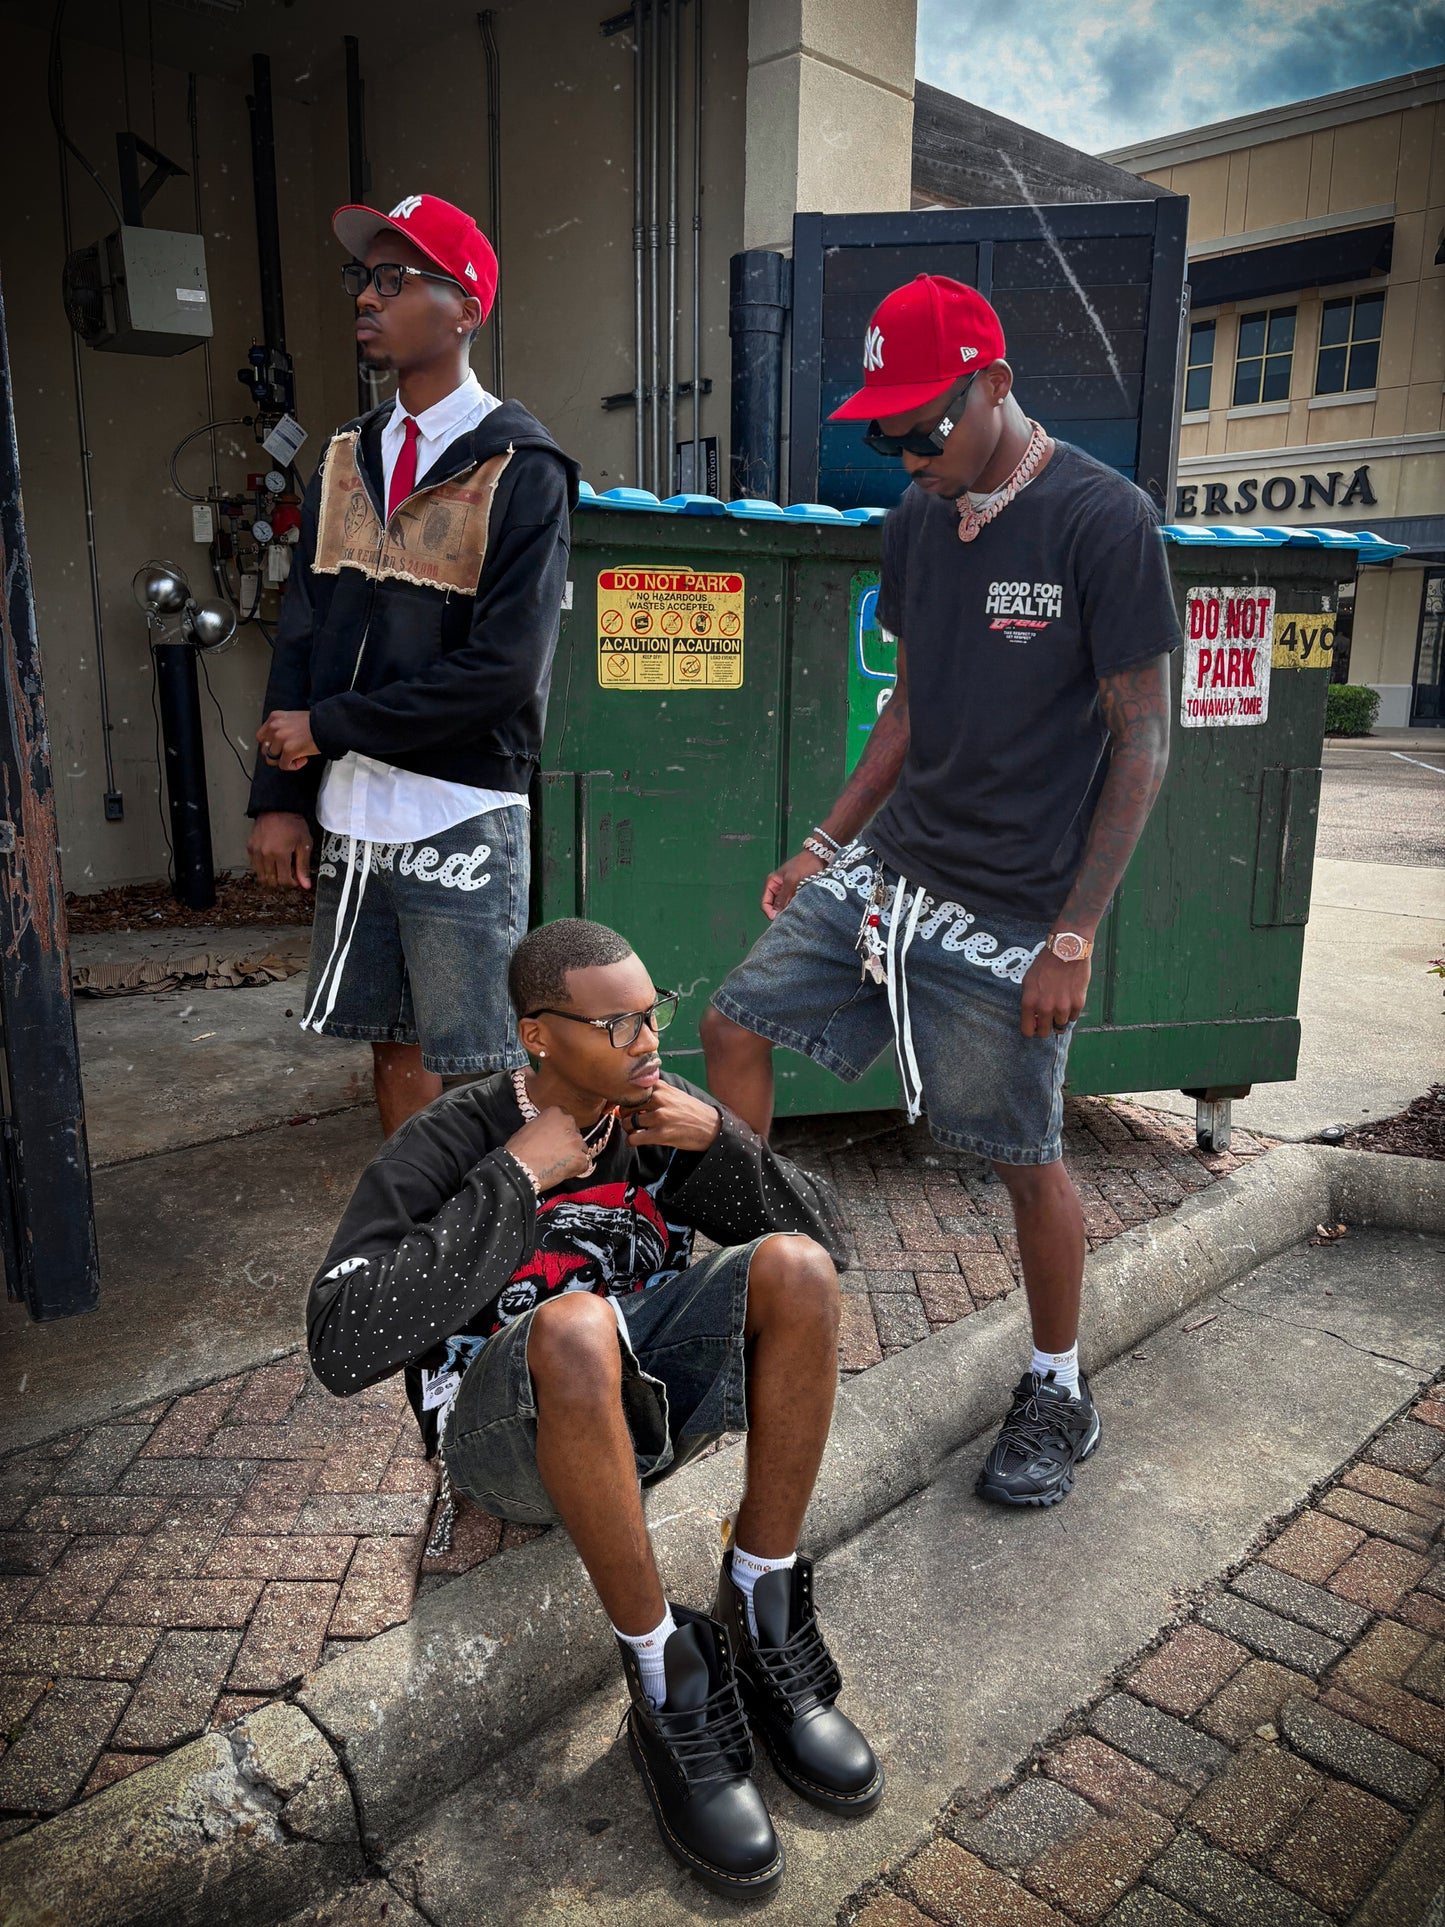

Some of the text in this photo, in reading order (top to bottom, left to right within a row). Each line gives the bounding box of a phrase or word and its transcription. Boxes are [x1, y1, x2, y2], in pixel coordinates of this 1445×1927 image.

[614, 574, 730, 592] DO NOT PARK
[988, 582, 1063, 599] GOOD FOR
[629, 602, 665, 610] WASTES
[637, 593, 707, 602] NO HAZARDOUS
[985, 596, 1062, 618] HEALTH
[1190, 598, 1270, 640] DO NOT
[614, 638, 669, 651] CAUTION
[687, 639, 740, 653] CAUTION
[1198, 648, 1257, 688] PARK
[1187, 697, 1262, 717] TOWAWAY ZONE
